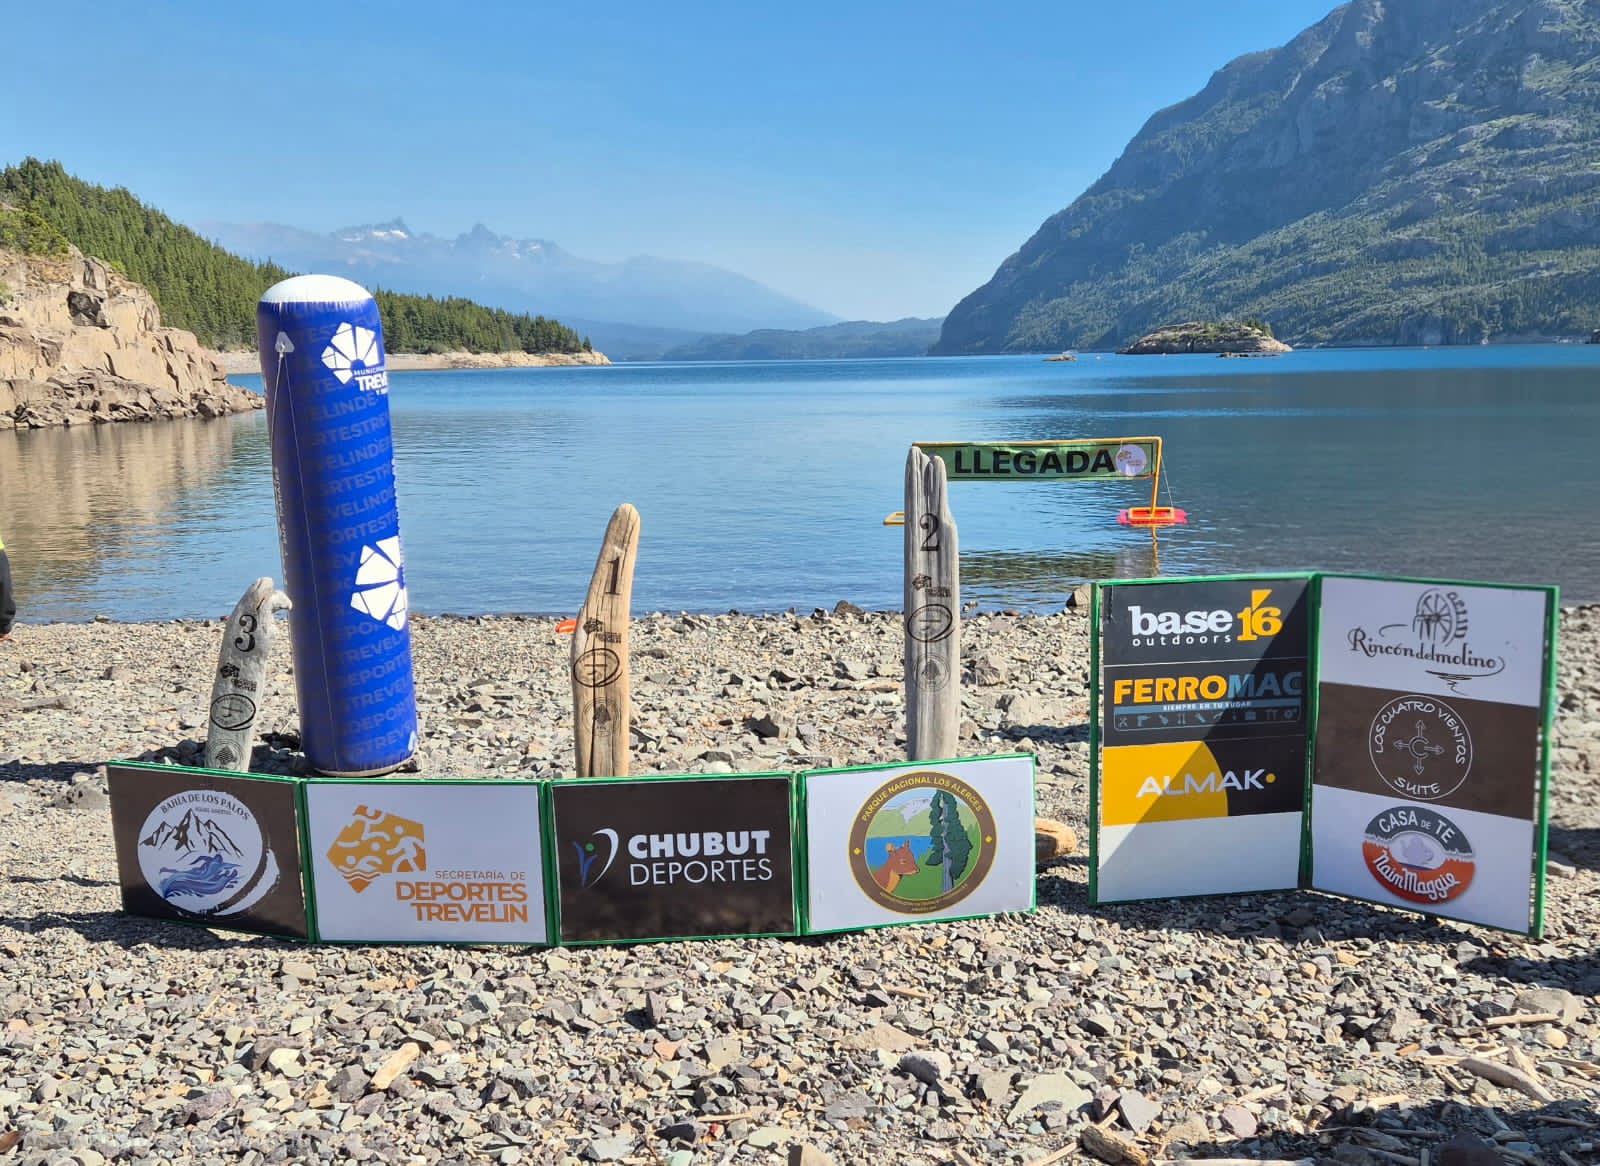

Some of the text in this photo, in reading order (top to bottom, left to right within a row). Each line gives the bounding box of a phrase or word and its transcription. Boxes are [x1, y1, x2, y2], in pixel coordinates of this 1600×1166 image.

[954, 449, 1115, 474] LLEGADA
[920, 513, 939, 551] 2
[605, 556, 620, 595] 1
[234, 615, 257, 652] 3
[1132, 635, 1232, 647] outdoors
[1113, 671, 1303, 704] FERROMAC
[1374, 701, 1466, 765] LOS CUATRO VIENTOS
[1136, 769, 1265, 798] ALMAK
[1394, 777, 1440, 795] SUITE
[188, 794, 200, 803] DE
[201, 794, 219, 805] LOS
[220, 799, 250, 821] PALOS
[861, 776, 983, 822] PARQUE NACIONAL LOS ALERCES
[1379, 810, 1456, 844] CASA DE TE
[628, 831, 770, 859] CHUBUT
[435, 869, 526, 880] SECRETARÍA DE
[630, 858, 773, 886] DEPORTES
[395, 881, 529, 902] DEPORTES
[410, 902, 529, 923] TREVELIN
